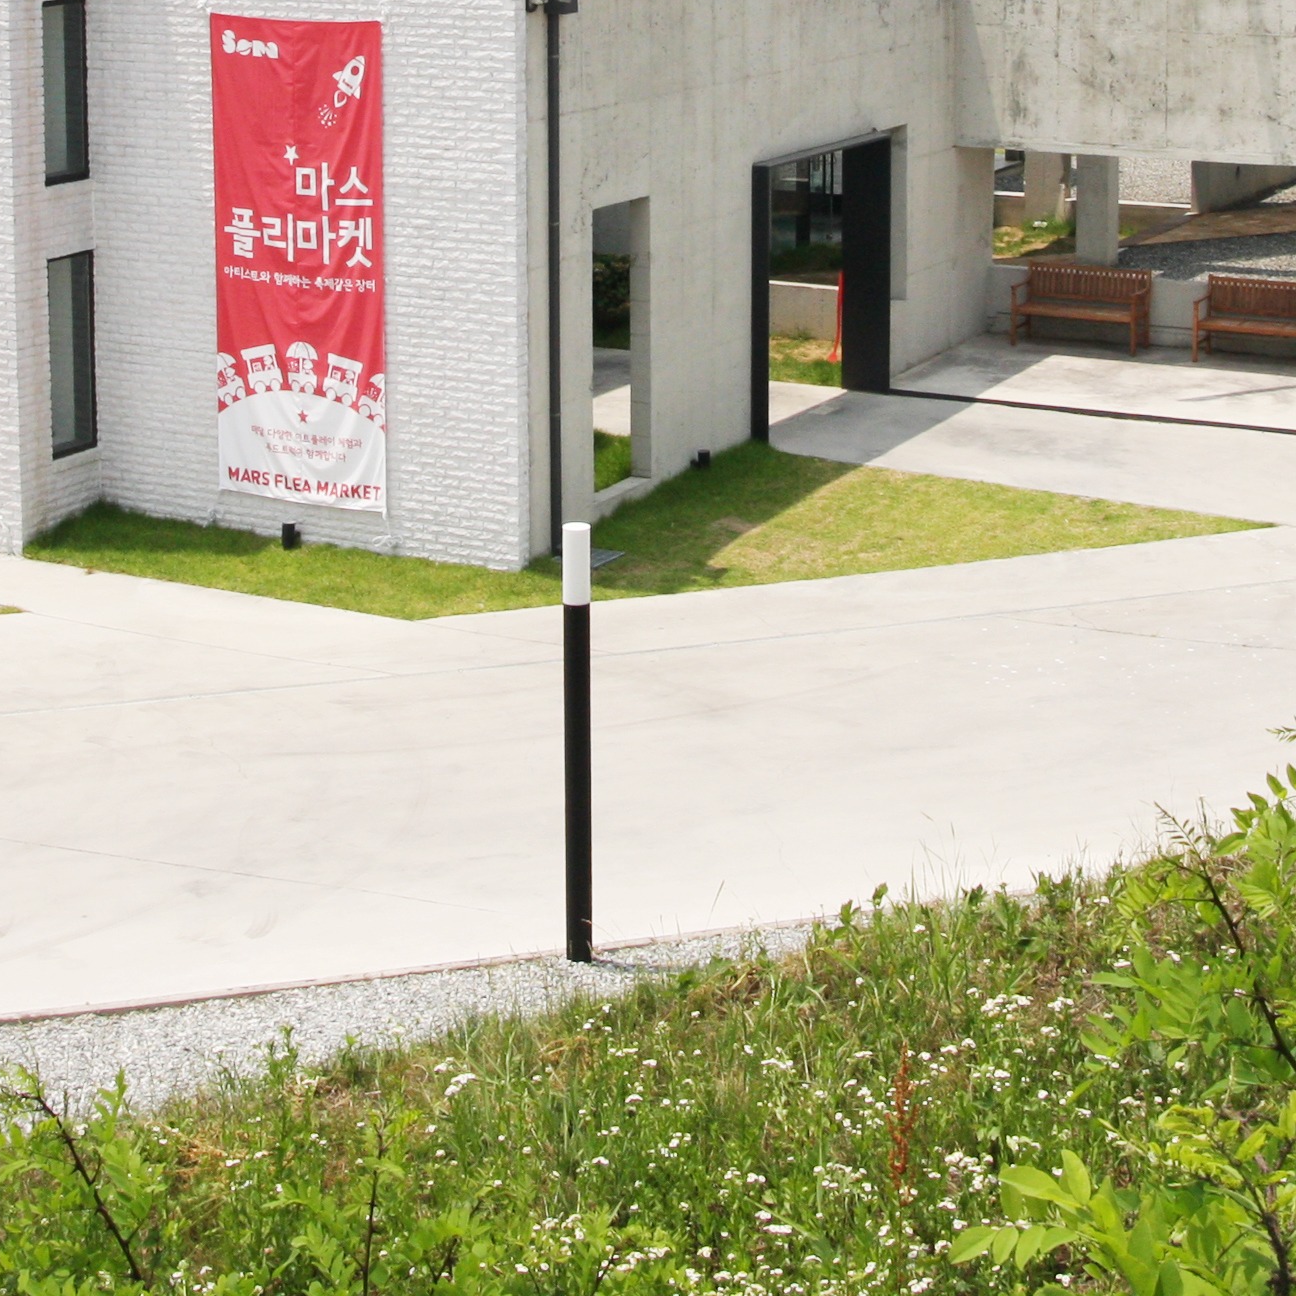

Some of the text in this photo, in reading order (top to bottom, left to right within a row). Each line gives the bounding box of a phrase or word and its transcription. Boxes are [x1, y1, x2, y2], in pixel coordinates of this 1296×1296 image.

[296, 162, 373, 211] 마스
[224, 207, 373, 267] 플리마켓
[356, 280, 375, 292] 장터
[268, 428, 292, 442] 다양한
[228, 466, 381, 500] MARS FLEA MARKET
